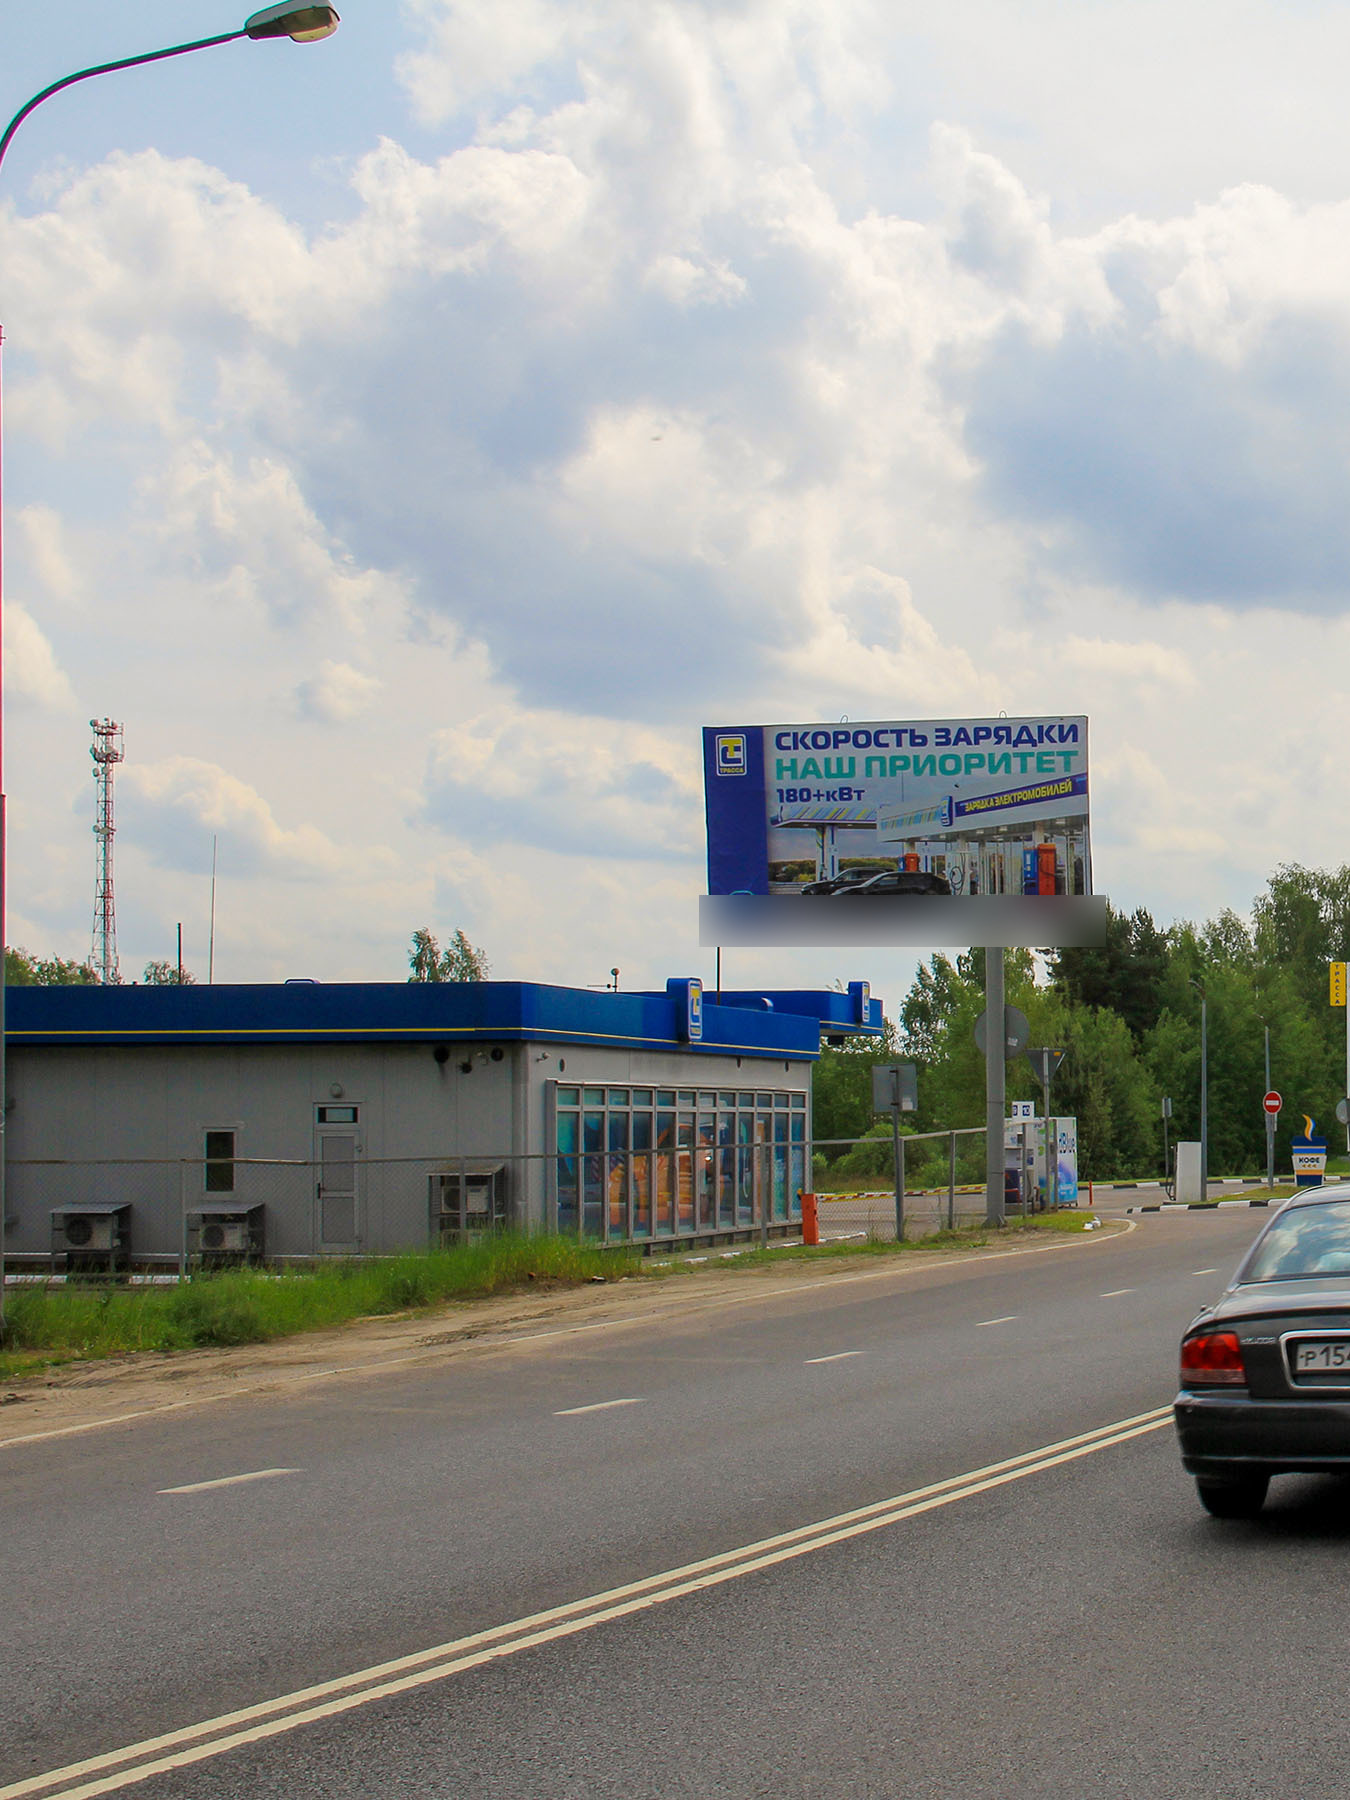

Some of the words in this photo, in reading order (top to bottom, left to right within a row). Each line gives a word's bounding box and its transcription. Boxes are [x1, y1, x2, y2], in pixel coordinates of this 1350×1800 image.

[775, 728, 928, 751] СКОРОСТЬ
[934, 724, 1079, 748] ЗАРЯДКИ
[776, 756, 856, 780] НАШ
[865, 750, 1079, 778] ПРИОРИТЕТ
[995, 778, 1073, 806] ЭЛЕКТРОМОБИЛЕЙ
[1298, 1156, 1320, 1164] КОФЕ
